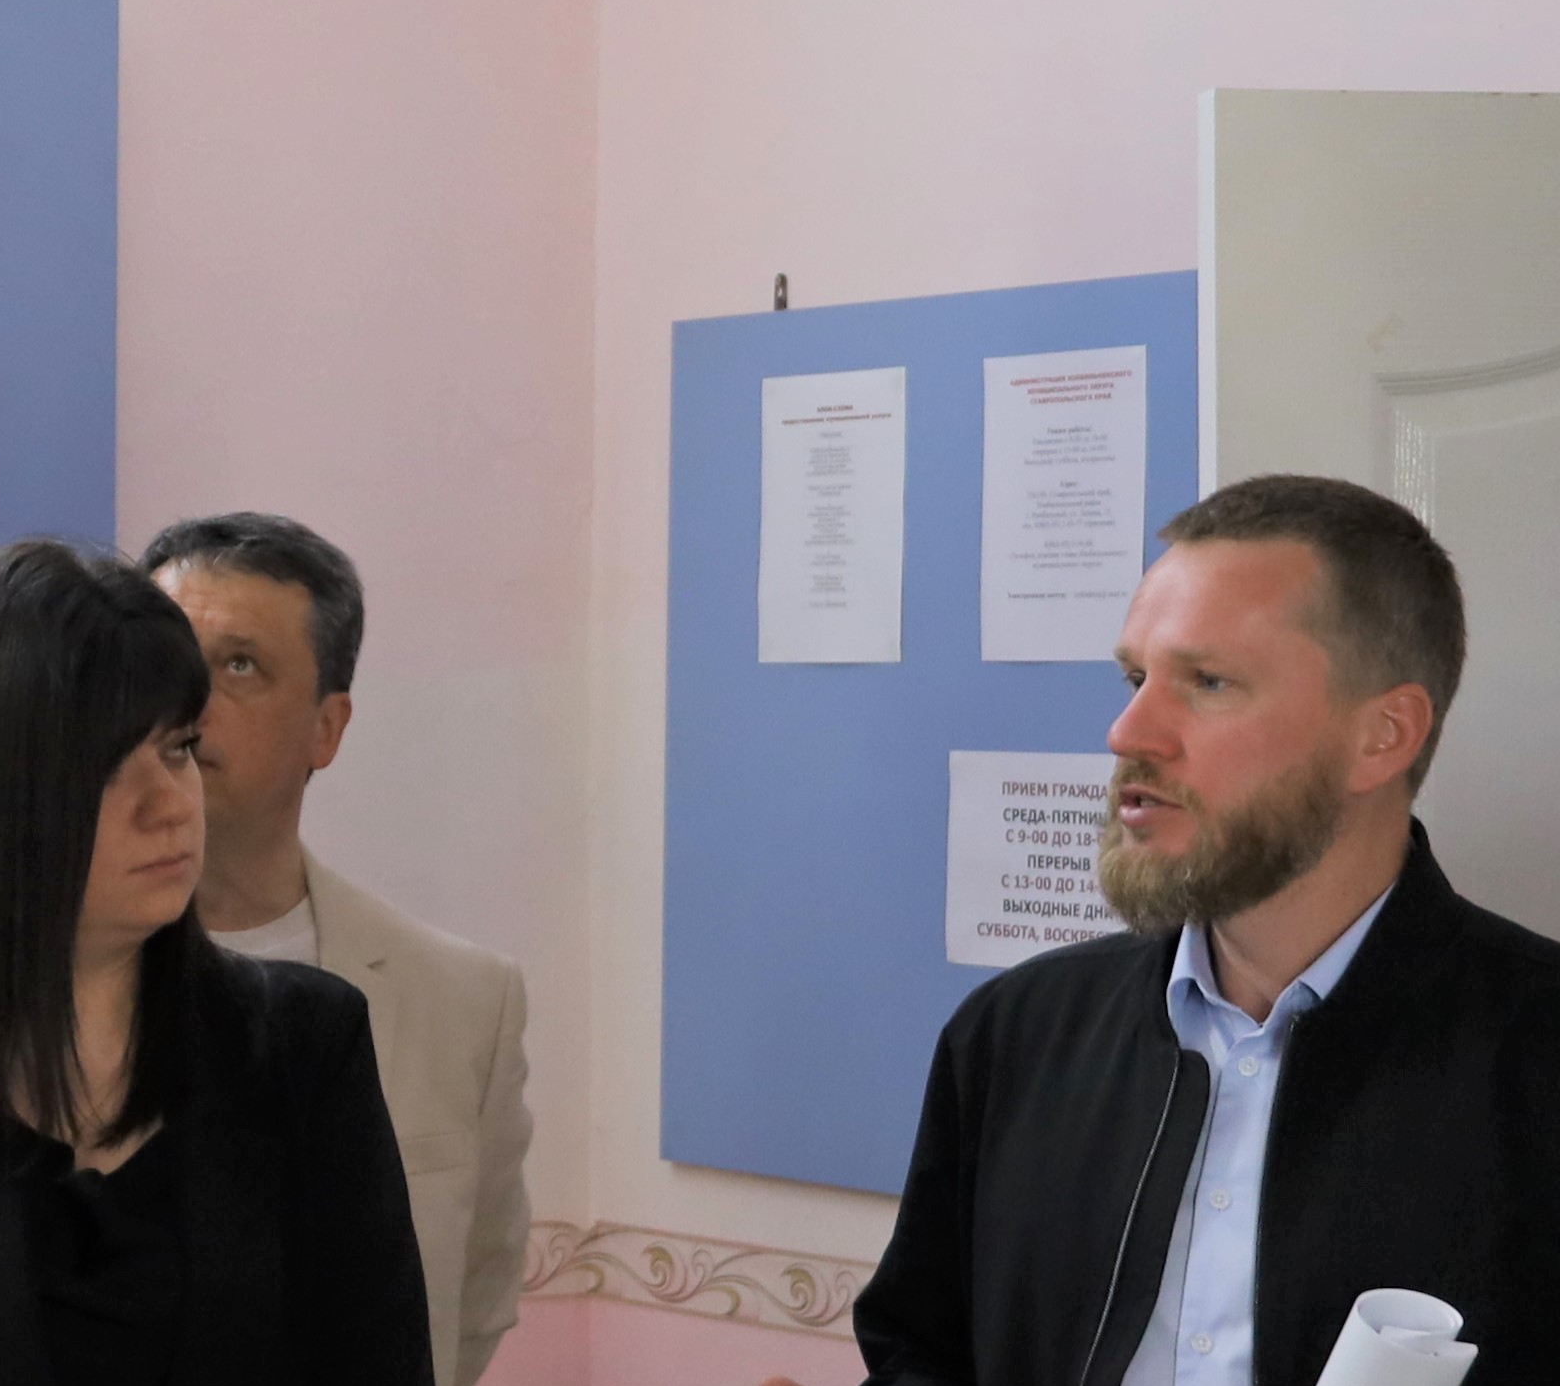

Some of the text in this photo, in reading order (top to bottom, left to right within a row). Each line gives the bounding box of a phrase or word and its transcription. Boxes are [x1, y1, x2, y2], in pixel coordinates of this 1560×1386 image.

[1002, 781, 1107, 800] ПРИЕМ ГРАЖДА
[1006, 829, 1013, 842] С
[1018, 830, 1048, 843] 9-00
[1052, 832, 1071, 847] ДО
[1028, 855, 1090, 870] ПЕРЕРЫВ
[1002, 875, 1099, 893] С 13-00 ДО 14-
[1003, 899, 1080, 917] ВЫХОДНЫЕ
[977, 922, 1039, 942] СУББОТА,
